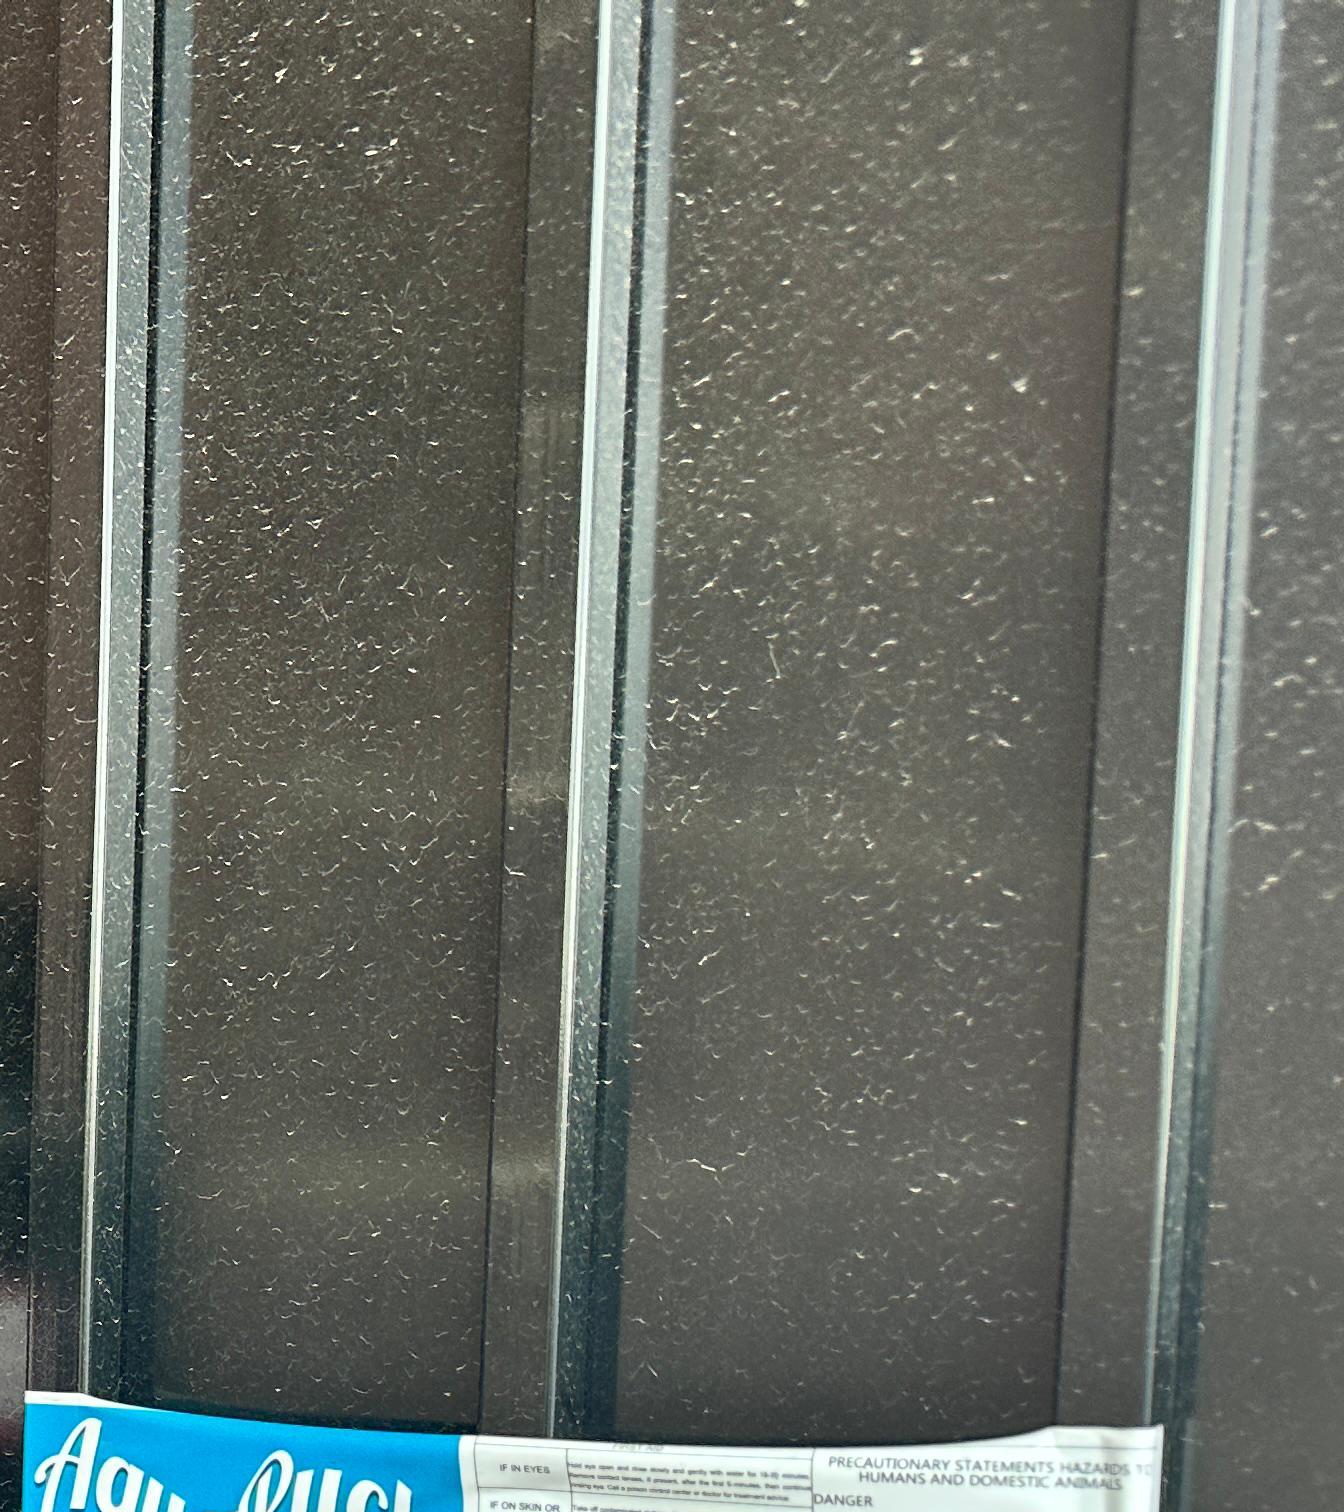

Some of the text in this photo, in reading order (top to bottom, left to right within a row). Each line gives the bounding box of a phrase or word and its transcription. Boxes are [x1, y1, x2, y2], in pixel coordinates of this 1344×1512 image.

[499, 1463, 551, 1474] IF IN EYES
[828, 1456, 951, 1470] PRECAUTIONARY
[955, 1459, 1054, 1473] STATEMENTS
[1060, 1462, 1130, 1476] HAZARDS
[859, 1471, 1123, 1490] HUMANS AND DOMESTIC ANIMALS
[490, 1500, 499, 1509] IF
[501, 1501, 516, 1510] ON
[518, 1502, 542, 1511] SKIN
[813, 1493, 873, 1507] DANGER
